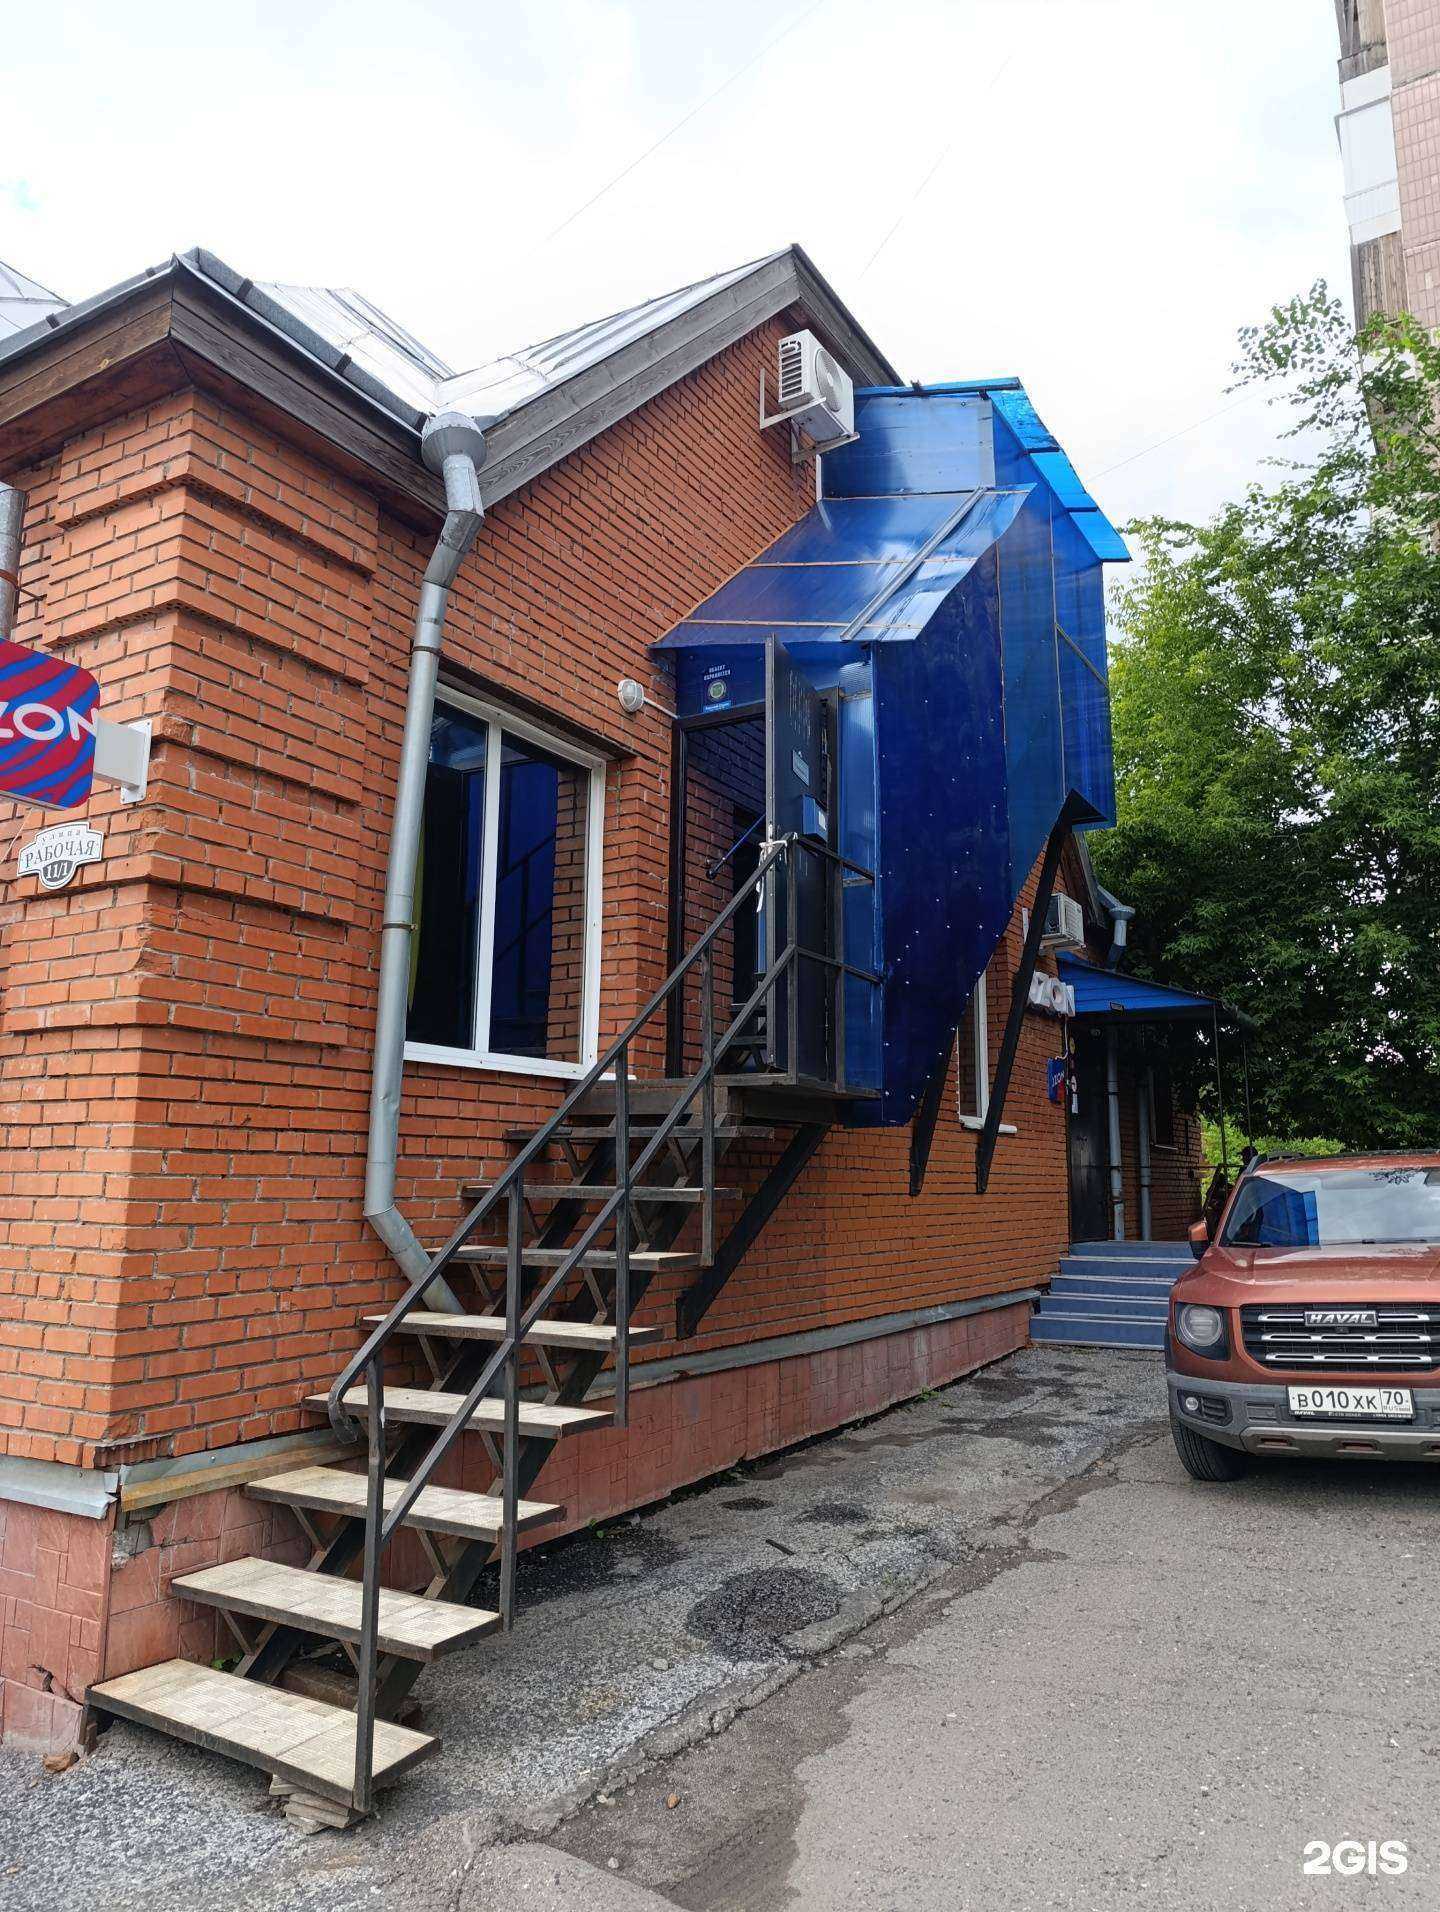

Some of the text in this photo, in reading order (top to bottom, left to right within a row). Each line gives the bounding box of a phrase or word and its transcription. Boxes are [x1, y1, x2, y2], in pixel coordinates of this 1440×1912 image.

[25, 840, 95, 868] РАБОЧАЯ
[1309, 1314, 1373, 1324] HAVAL
[1382, 1391, 1404, 1405] 70
